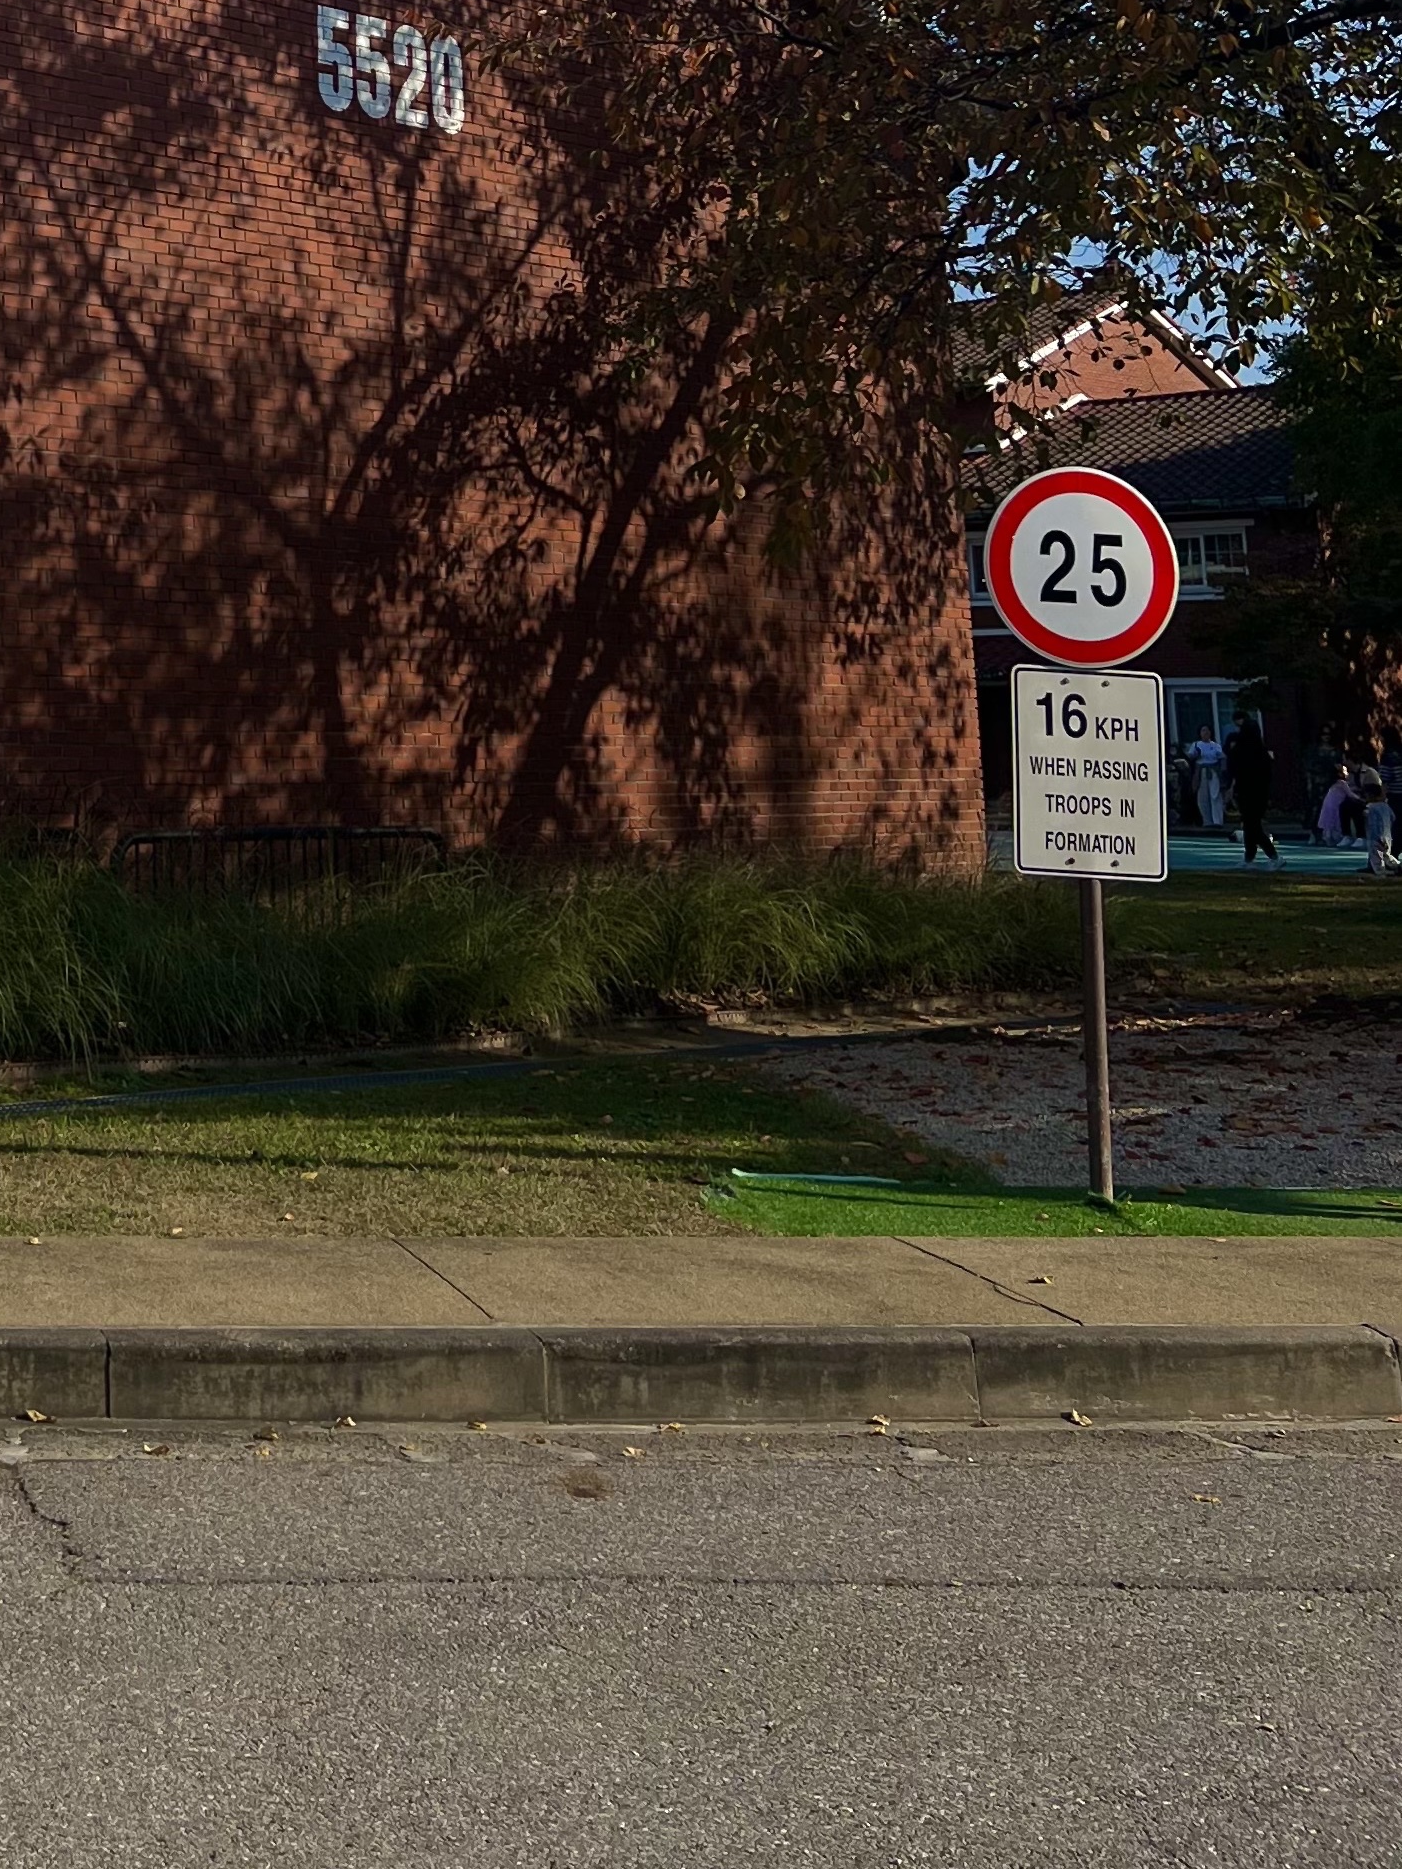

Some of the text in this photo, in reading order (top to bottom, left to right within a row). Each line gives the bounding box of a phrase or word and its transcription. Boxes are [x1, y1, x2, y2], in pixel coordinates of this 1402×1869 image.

[317, 4, 465, 134] 5520
[1039, 529, 1127, 607] 25
[1036, 692, 1139, 742] 16 KPH
[1029, 756, 1149, 782] WHEN PASSING
[1045, 793, 1135, 819] TROOPS IN
[1045, 832, 1136, 857] FORMATION
